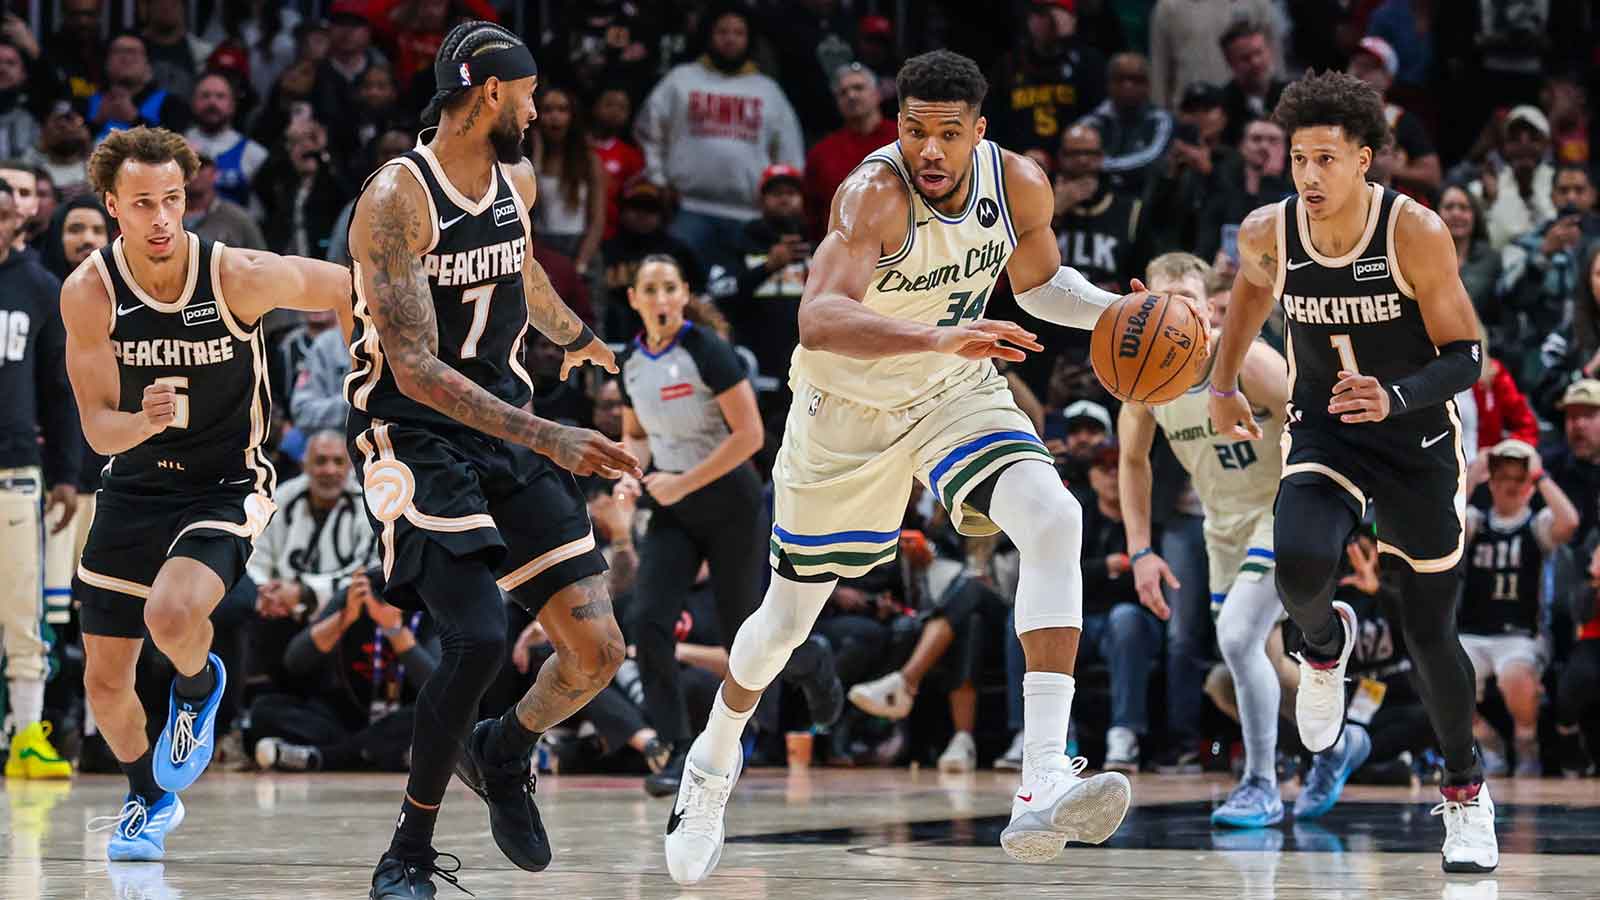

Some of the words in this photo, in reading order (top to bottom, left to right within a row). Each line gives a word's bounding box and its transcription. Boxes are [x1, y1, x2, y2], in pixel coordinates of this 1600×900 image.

[496, 204, 515, 220] paze
[876, 263, 960, 292] Cream
[963, 240, 1006, 279] City
[1356, 262, 1385, 276] paze
[186, 306, 216, 322] paze
[936, 284, 991, 326] 34
[1283, 293, 1402, 324] PEACHTREE
[461, 283, 497, 360] 7
[1119, 294, 1161, 358] Wilson
[1213, 441, 1257, 470] 20
